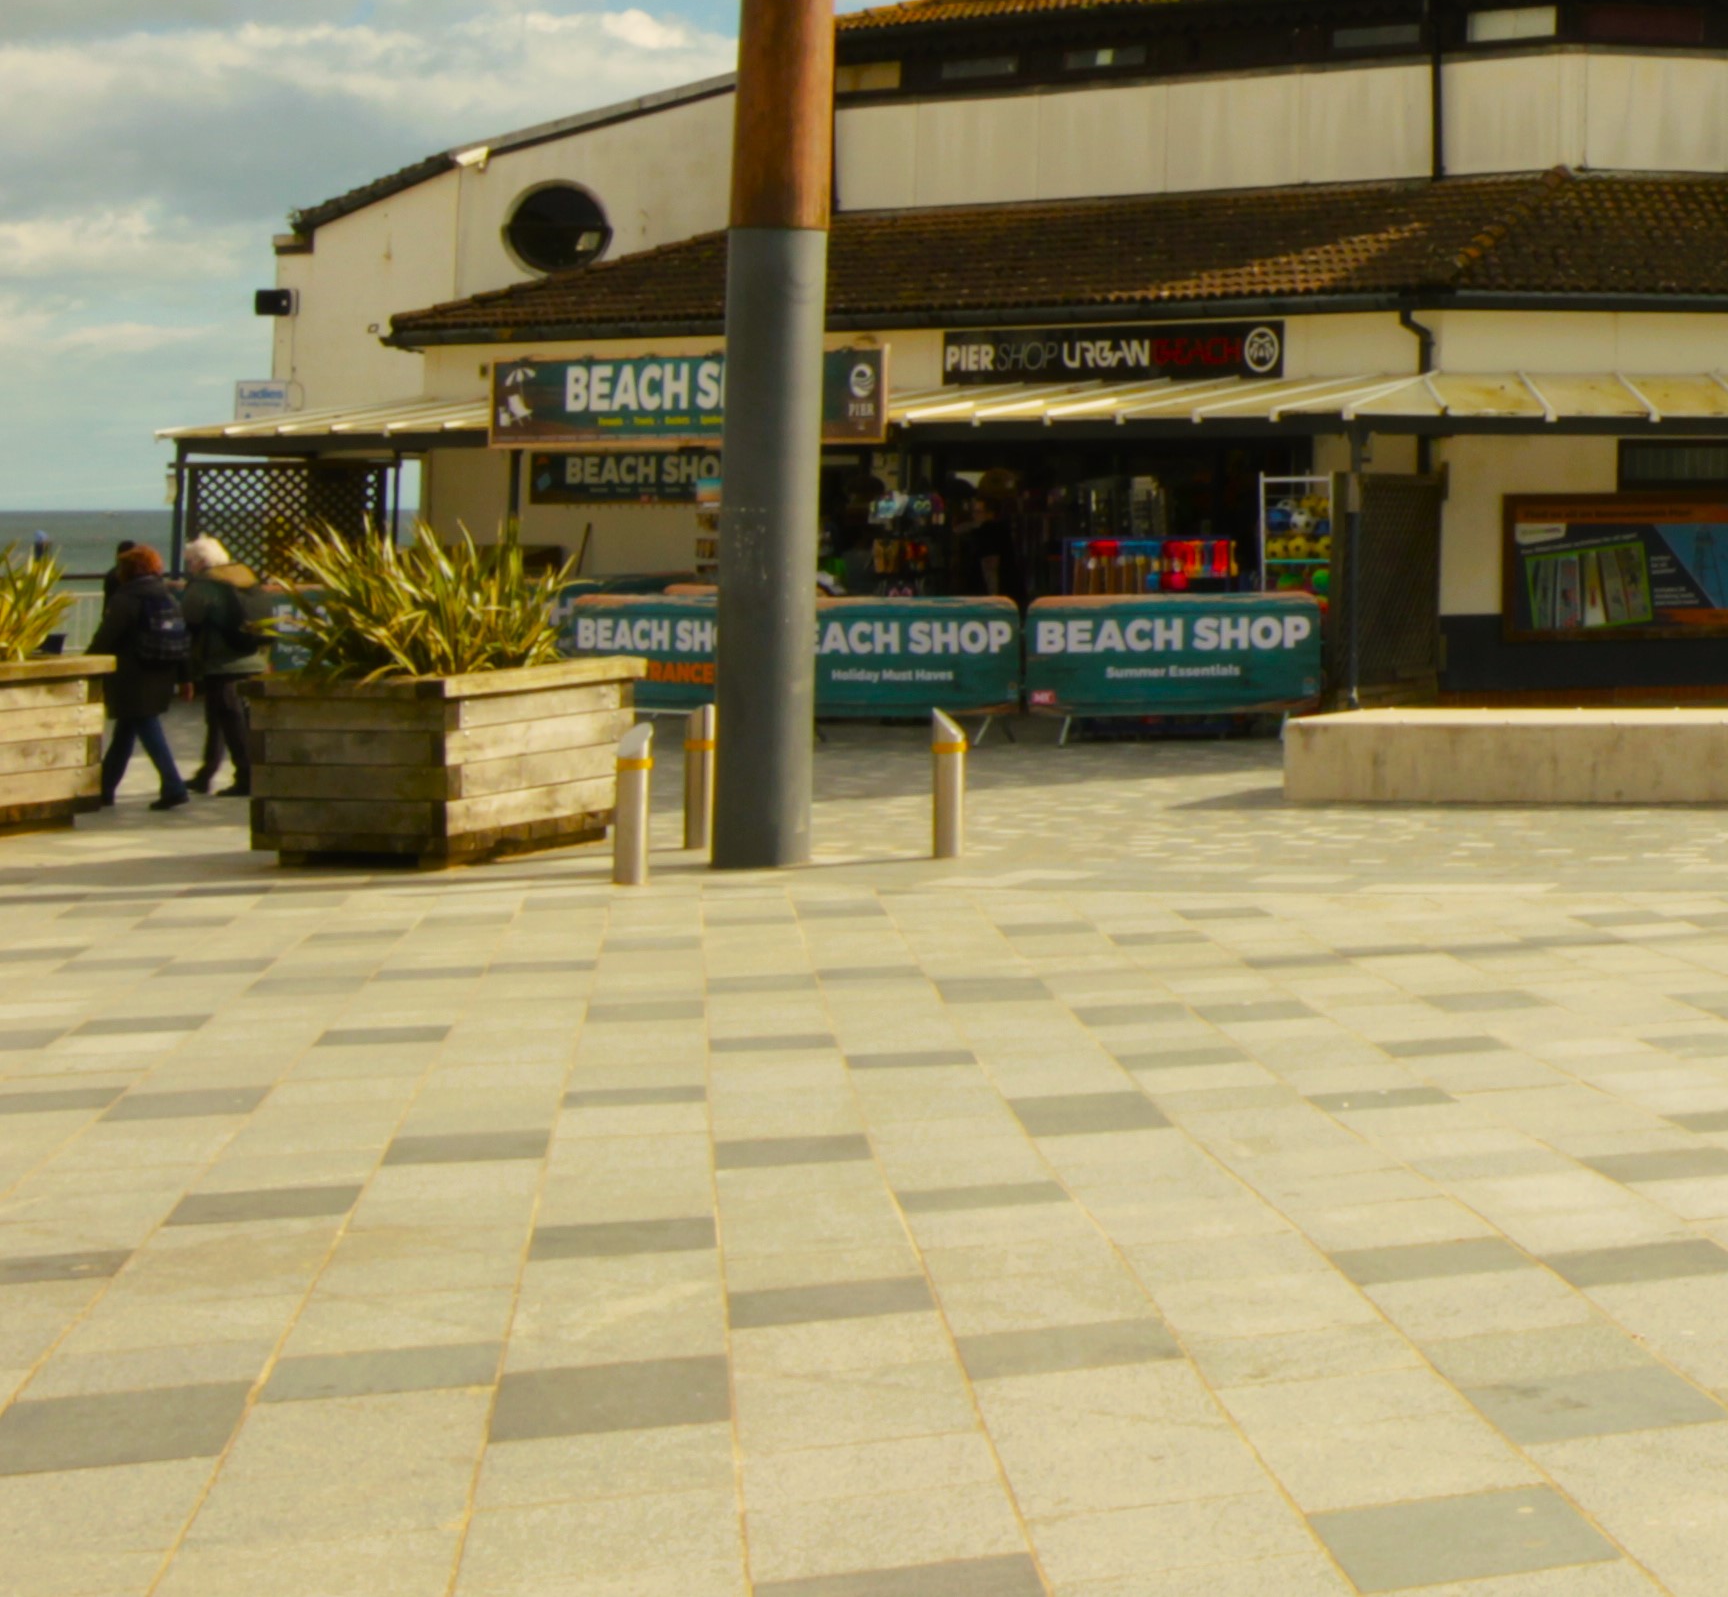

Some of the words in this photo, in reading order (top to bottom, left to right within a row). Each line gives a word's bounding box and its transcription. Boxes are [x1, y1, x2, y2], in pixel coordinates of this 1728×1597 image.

[946, 344, 994, 372] PIER
[996, 342, 1059, 371] SHOP
[1062, 338, 1151, 369] URBAN
[565, 362, 690, 412] BEACH
[565, 455, 657, 485] BEACH
[577, 617, 670, 651] BEACH
[908, 620, 1013, 654] SHOP
[1036, 617, 1184, 654] BEACH
[1192, 615, 1312, 650] SHOP
[831, 669, 880, 683] Holiday
[881, 669, 913, 681] Must
[915, 669, 954, 682] Haves
[1105, 666, 1167, 679] Summer
[1168, 664, 1241, 678] Essentials
